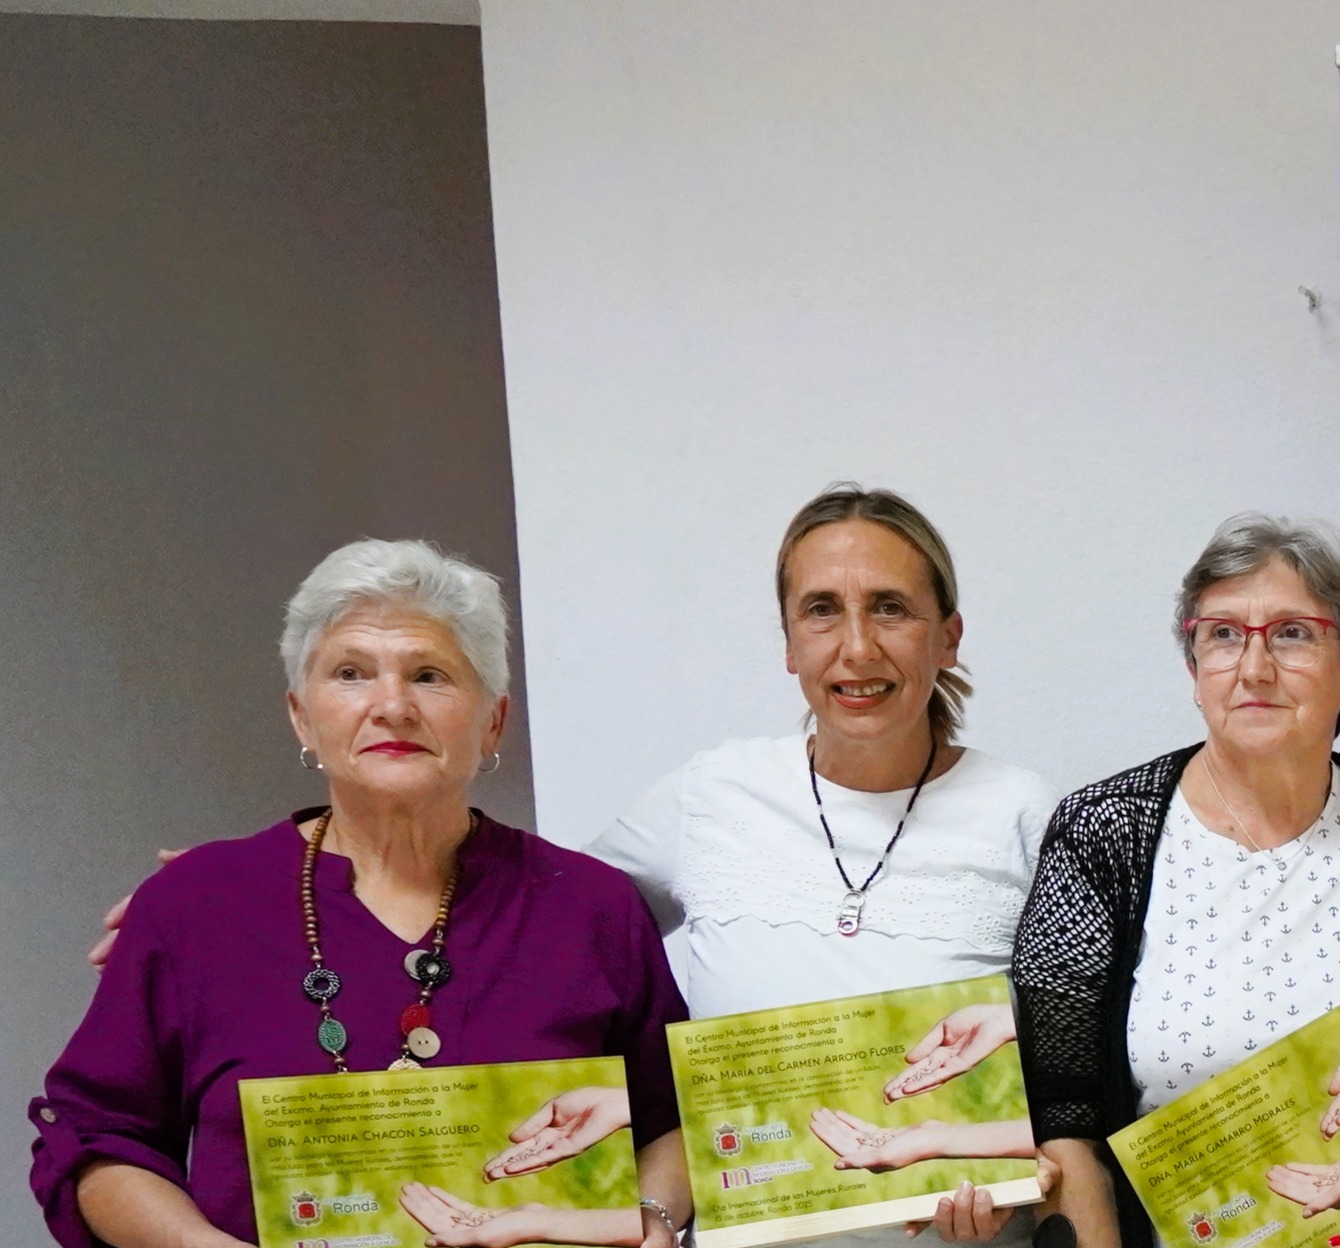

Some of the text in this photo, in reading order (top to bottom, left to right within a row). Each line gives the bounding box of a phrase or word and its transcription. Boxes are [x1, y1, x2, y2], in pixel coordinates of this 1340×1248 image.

[684, 1035, 693, 1044] El
[694, 1033, 724, 1043] Centro
[725, 1025, 766, 1037] Municipal
[851, 1009, 875, 1018] Mujer
[687, 1047, 700, 1055] del
[734, 1033, 793, 1048] Ayuntamiento
[795, 1031, 806, 1039] de
[808, 1026, 836, 1036] Ronda
[688, 1038, 835, 1066] Otorga el presente reconocimiento
[756, 1065, 775, 1075] DEL
[776, 1057, 820, 1071] CARMEN
[823, 1050, 867, 1064] ARROYO
[868, 1044, 905, 1057] FLORES
[261, 1095, 270, 1104] El
[272, 1094, 306, 1103] Centro
[308, 1090, 354, 1100] Municipal
[357, 1089, 370, 1097] de
[452, 1082, 478, 1091] Mujer
[1128, 1141, 1137, 1150] El
[1136, 1128, 1163, 1145] Centro
[1162, 1106, 1198, 1131] Municipal
[1198, 1101, 1209, 1110] de
[1258, 1067, 1268, 1075] la
[1267, 1056, 1287, 1070] Mujer
[263, 1107, 278, 1116] del
[319, 1101, 385, 1112] Ayuntamiento
[387, 1099, 400, 1107] de
[402, 1097, 435, 1106] Ronda
[264, 1119, 301, 1128] Otorga
[314, 1114, 357, 1125] presente
[359, 1110, 432, 1121] reconocimiento
[1135, 1148, 1147, 1160] del
[1175, 1105, 1225, 1137] Ayuntamiento
[1225, 1099, 1235, 1108] de
[1235, 1084, 1261, 1102] Ronda
[1205, 1122, 1252, 1153] GAMARRO
[1252, 1097, 1295, 1126] MORALES
[302, 1133, 358, 1145] ANTONIA
[418, 1123, 480, 1137] SALGUERO
[751, 1128, 791, 1142] Ronda
[1139, 1151, 1168, 1170] Otorga
[1168, 1145, 1176, 1154] el
[1176, 1128, 1208, 1151] presente
[1209, 1097, 1263, 1130] reconocimiento
[805, 1187, 836, 1197] Mujeres
[837, 1182, 866, 1192] Rurales
[332, 1200, 378, 1213] Ronda
[1220, 1197, 1256, 1221] Ronda
[1312, 1221, 1337, 1237] Rurales
